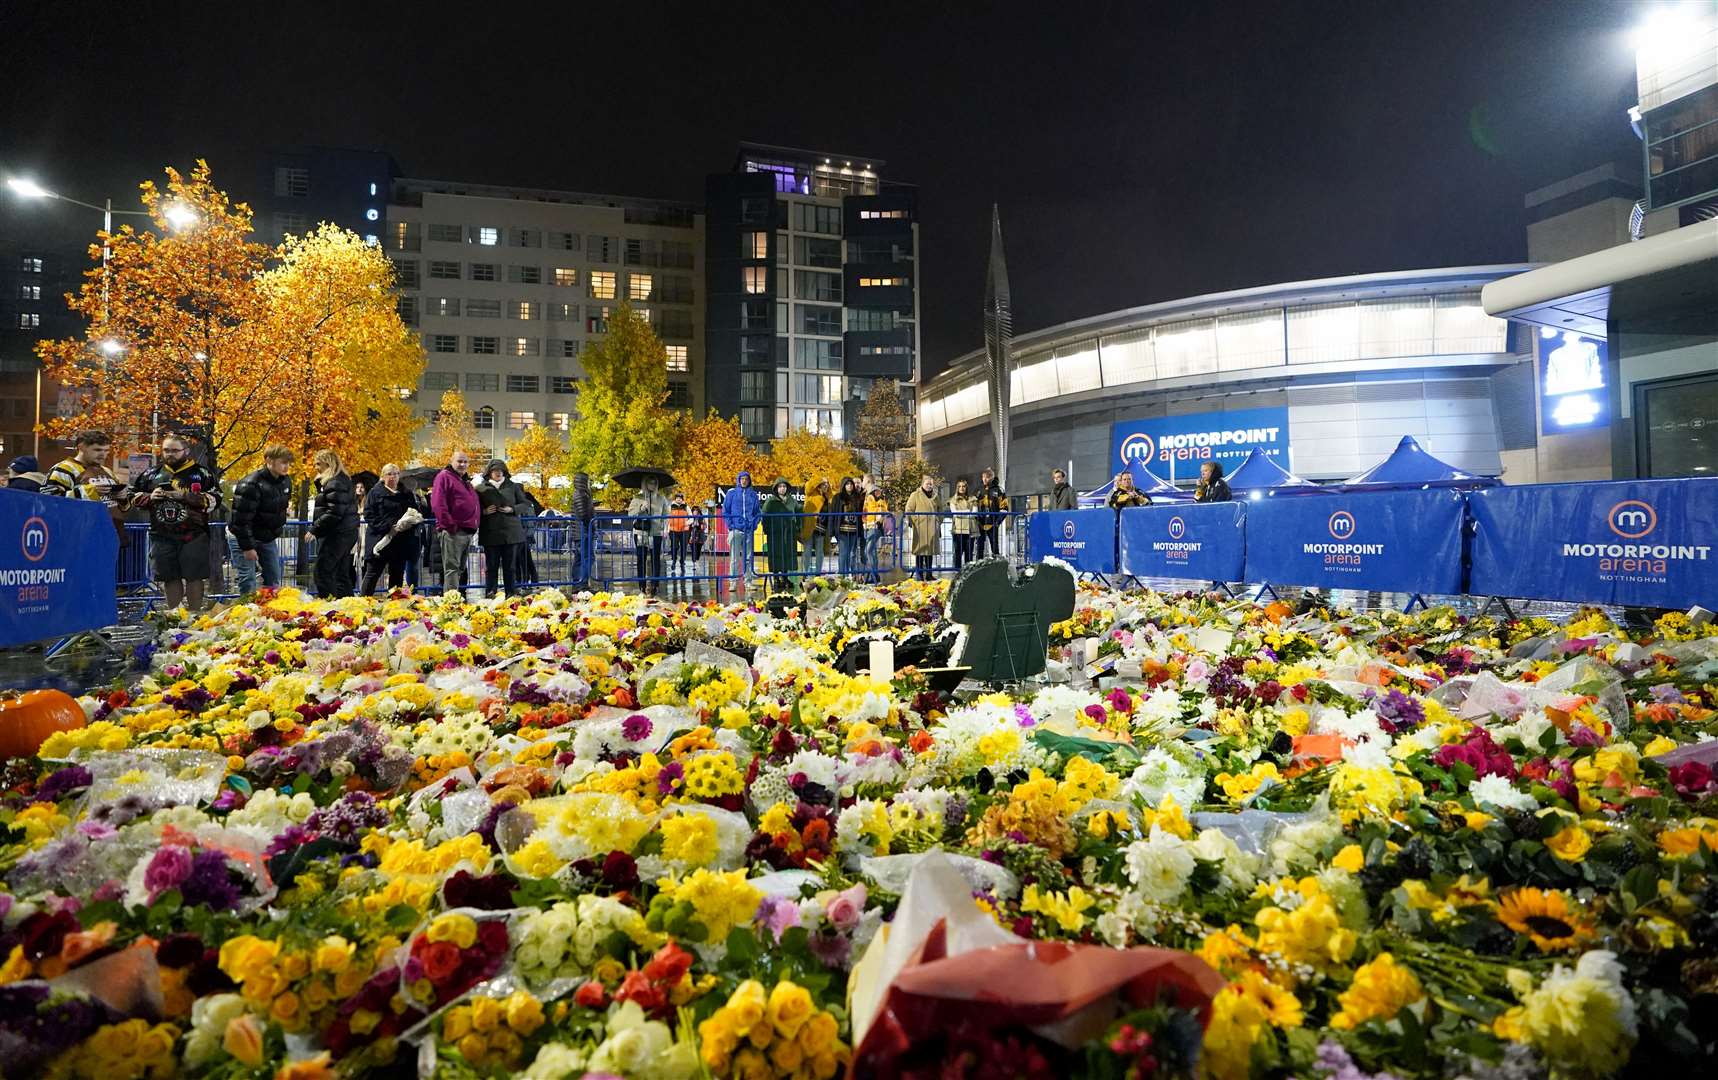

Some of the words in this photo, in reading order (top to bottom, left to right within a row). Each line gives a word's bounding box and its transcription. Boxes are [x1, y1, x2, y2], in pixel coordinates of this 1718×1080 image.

[1159, 428, 1279, 449] MOTORPOINT
[1159, 446, 1212, 461] arena
[1215, 449, 1280, 458] NOTTINAM
[1053, 541, 1086, 549] MOTORPOINT
[1153, 542, 1202, 551] MOTORPOINT
[1303, 543, 1384, 555] MOTORPOINT
[1563, 543, 1711, 560] MOTORPOINT
[1166, 550, 1188, 559] arena
[1324, 553, 1361, 565] arena
[1599, 557, 1667, 574] arena
[0, 568, 66, 586] MOTORPOINT
[1599, 574, 1667, 584] NOTTINGHAM
[18, 586, 49, 601] arena
